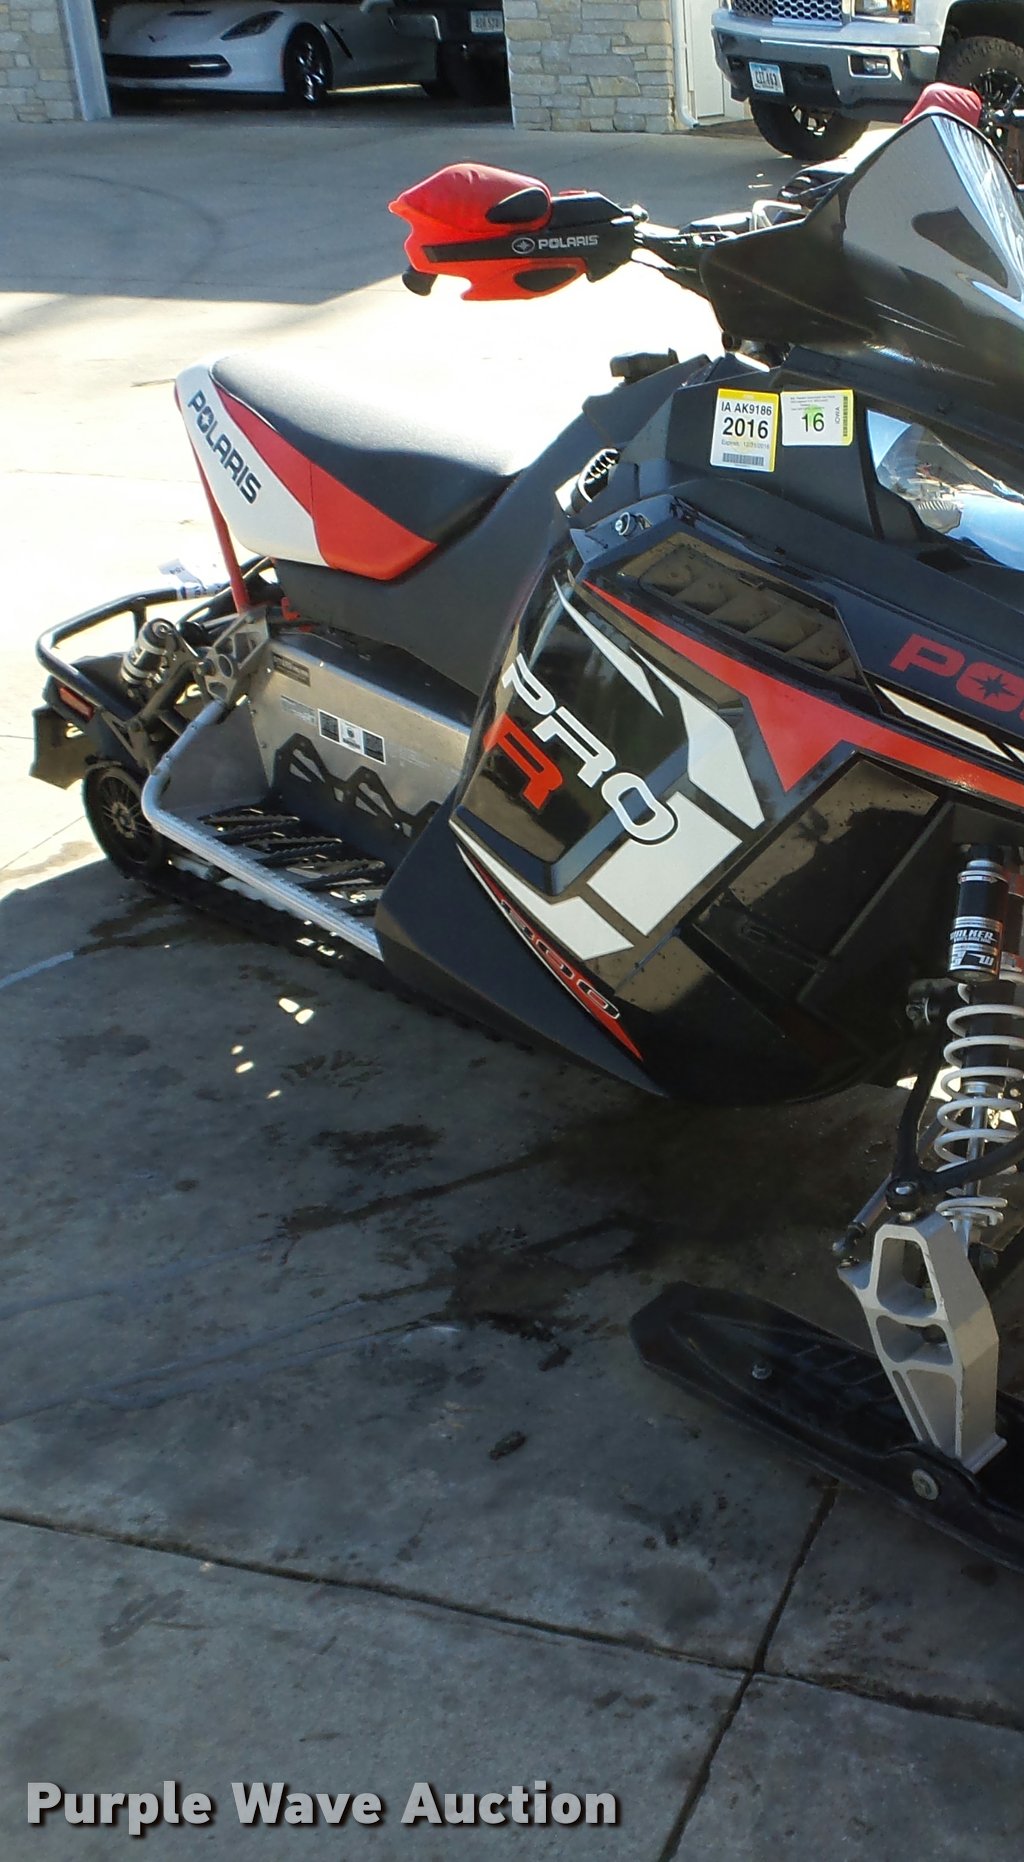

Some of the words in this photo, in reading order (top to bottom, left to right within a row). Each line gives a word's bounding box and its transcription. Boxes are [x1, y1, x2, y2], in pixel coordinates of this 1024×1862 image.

[538, 234, 599, 250] POLARIS
[721, 401, 732, 413] IA
[734, 402, 773, 417] AK9186
[722, 416, 769, 440] 2016
[801, 412, 825, 433] 16
[187, 389, 262, 504] POLARIS
[501, 652, 679, 844] PRO
[482, 711, 563, 810] R
